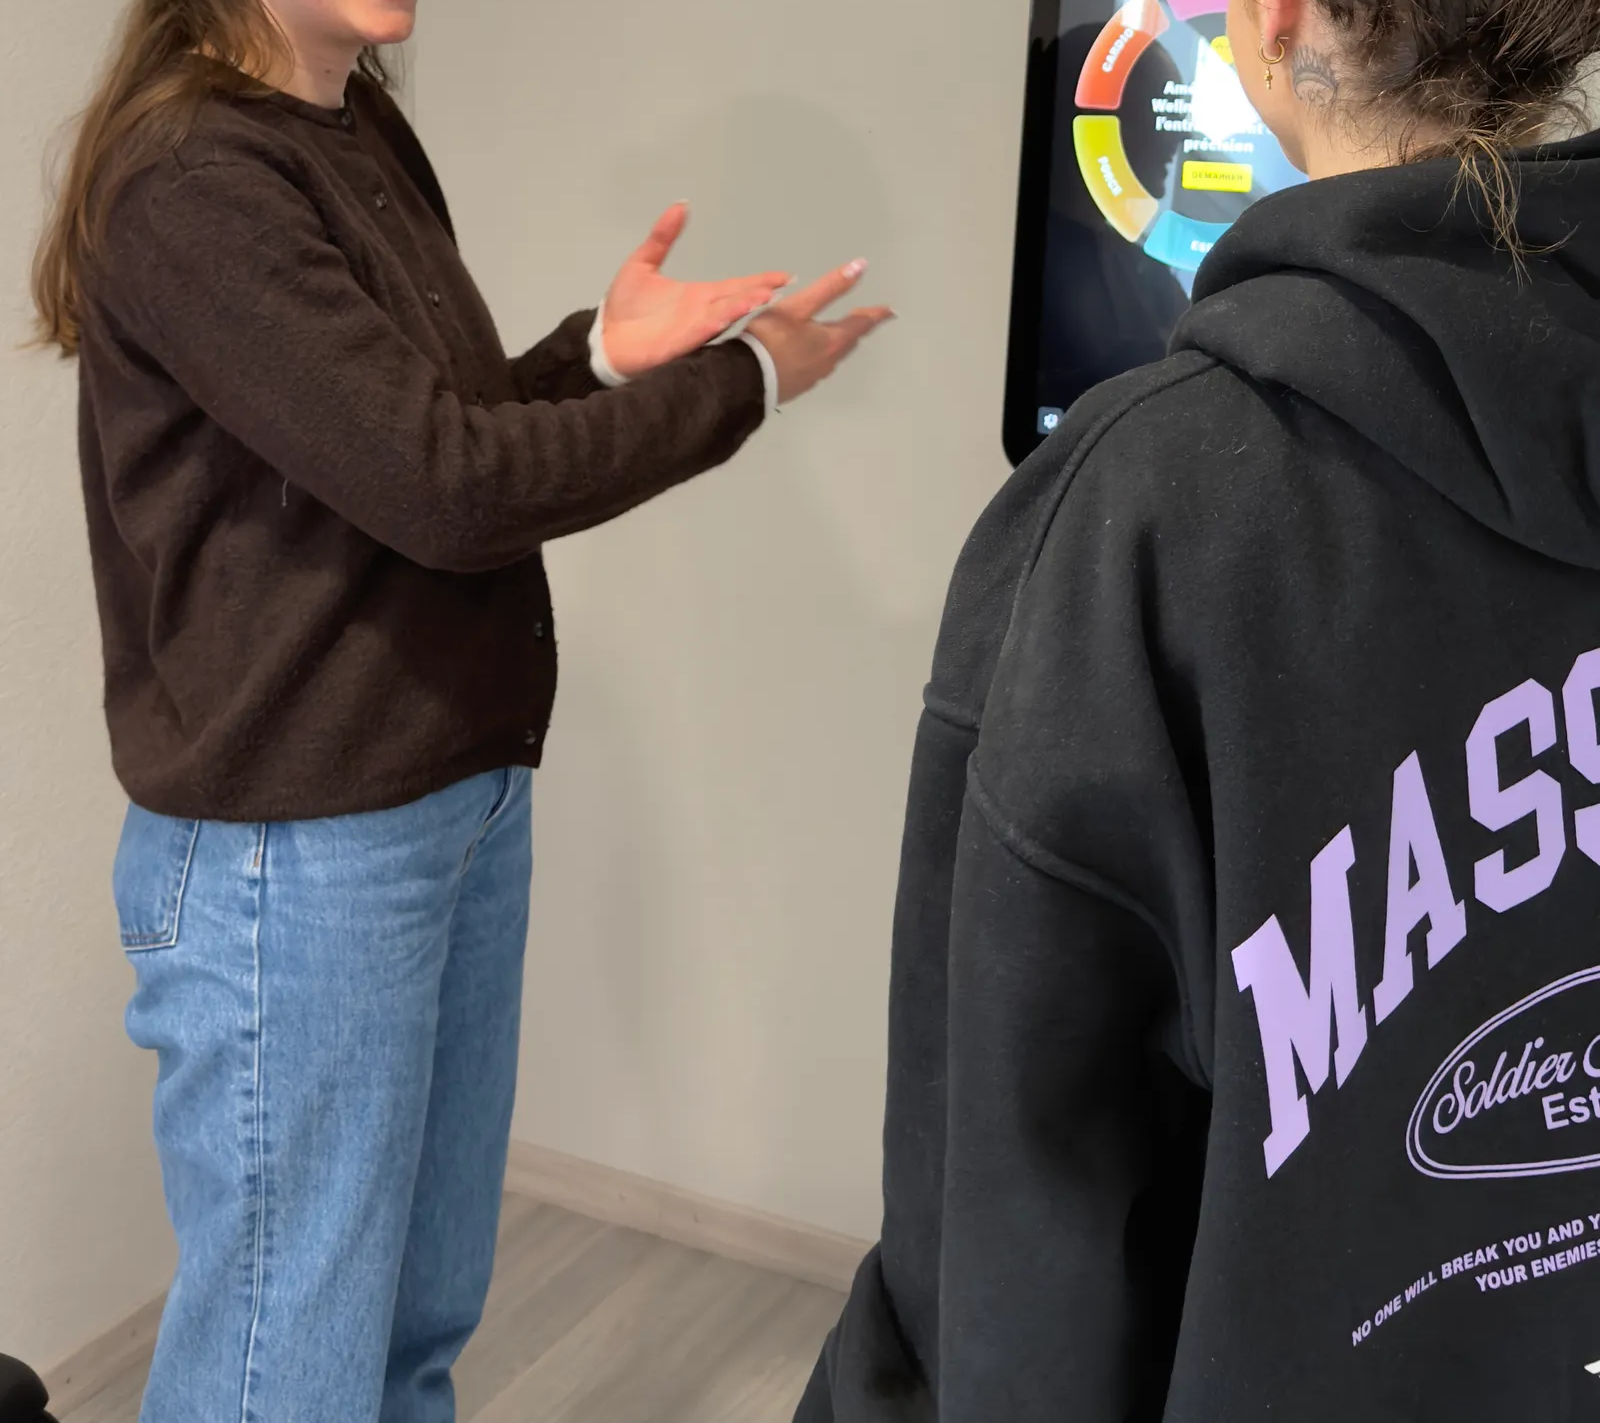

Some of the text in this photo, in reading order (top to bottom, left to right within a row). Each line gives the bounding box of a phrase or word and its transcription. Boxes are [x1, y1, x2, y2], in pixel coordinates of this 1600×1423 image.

[1102, 27, 1134, 73] CARDIO
[1433, 1036, 1577, 1134] Soldier
[1352, 1319, 1372, 1346] NO
[1374, 1294, 1402, 1327] ONE
[1405, 1271, 1438, 1303] WILL
[1441, 1243, 1500, 1280] BREAK
[1503, 1231, 1542, 1257] YOU
[1547, 1219, 1585, 1245] AND
[1475, 1238, 1600, 1292] YOUR ENEMIE
